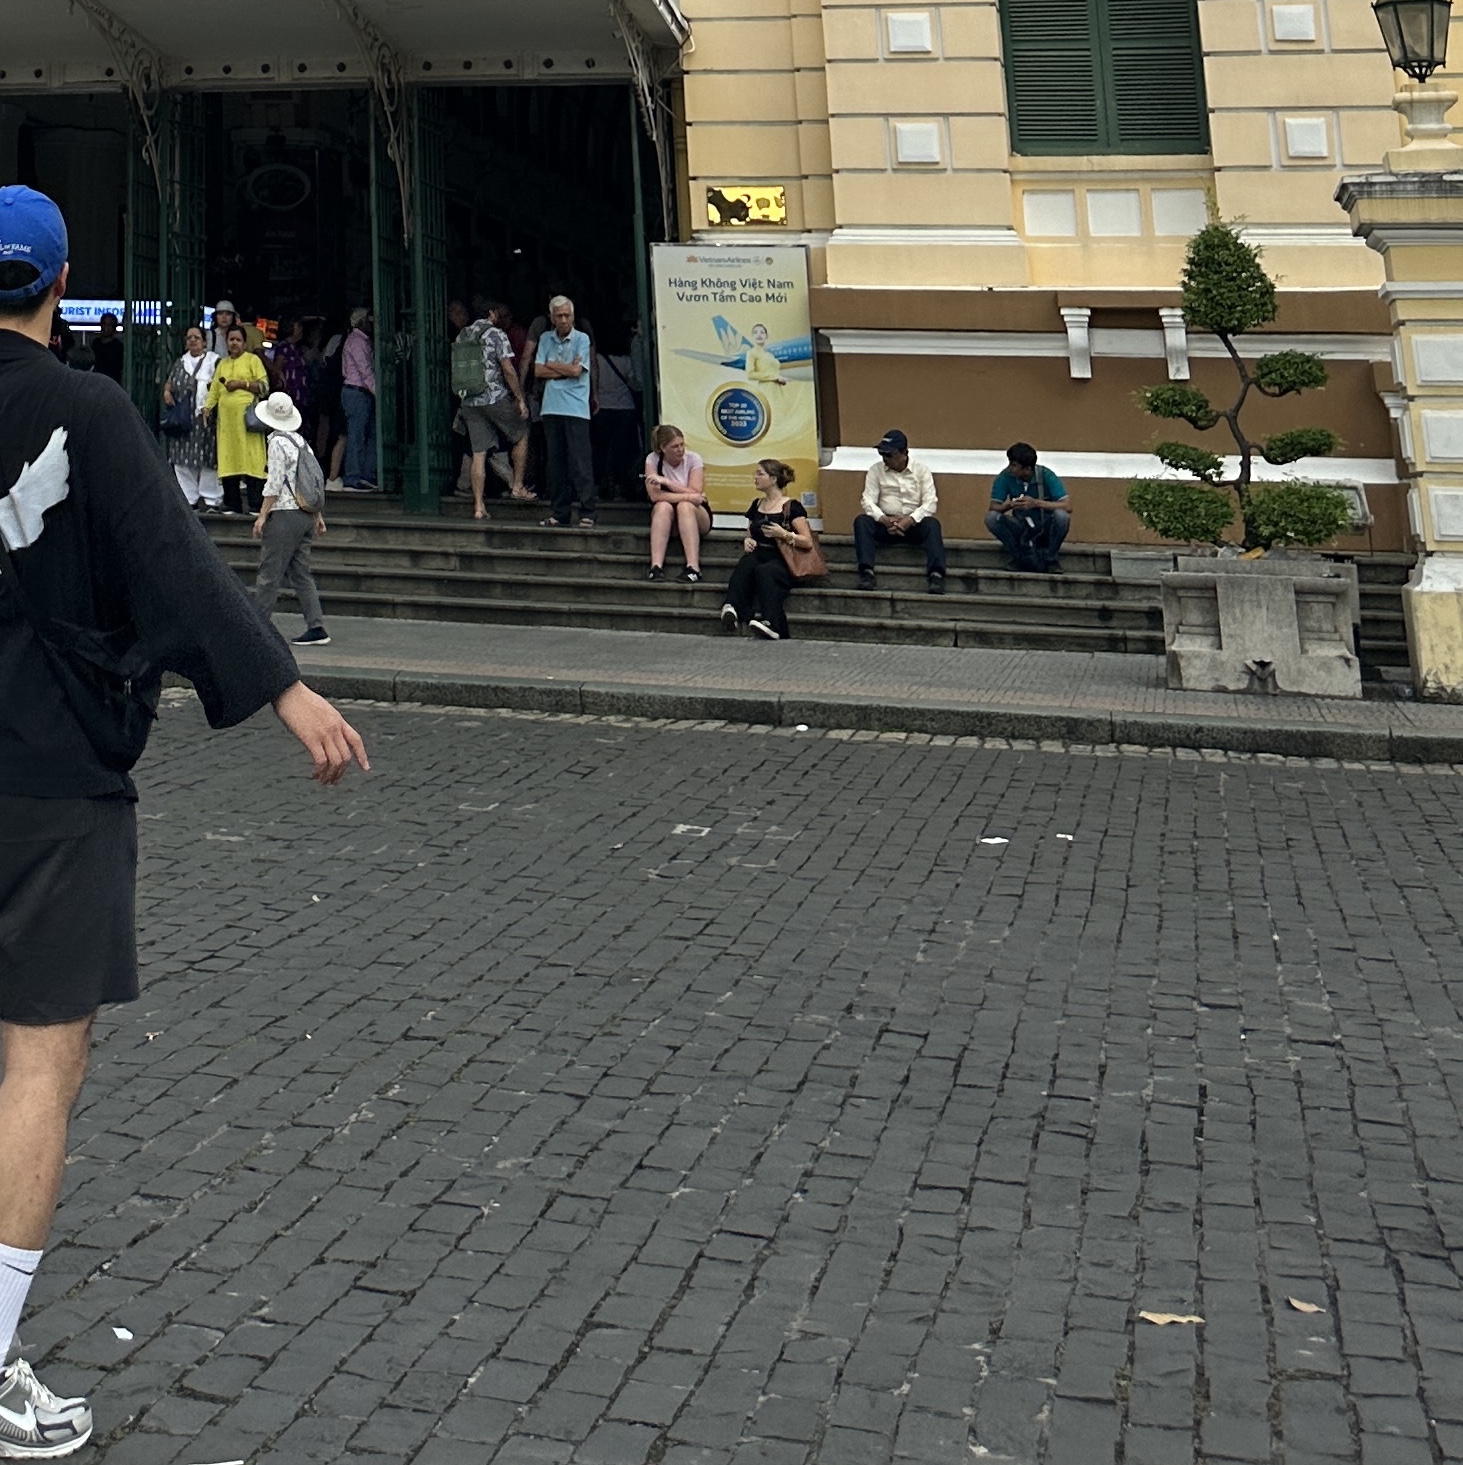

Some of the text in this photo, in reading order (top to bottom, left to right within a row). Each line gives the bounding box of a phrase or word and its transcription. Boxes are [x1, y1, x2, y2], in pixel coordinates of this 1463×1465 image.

[668, 277, 794, 291] Hàng Không Việt Nam
[676, 290, 788, 303] Vươn Tầm Cao Mới
[61, 306, 92, 316] URIST
